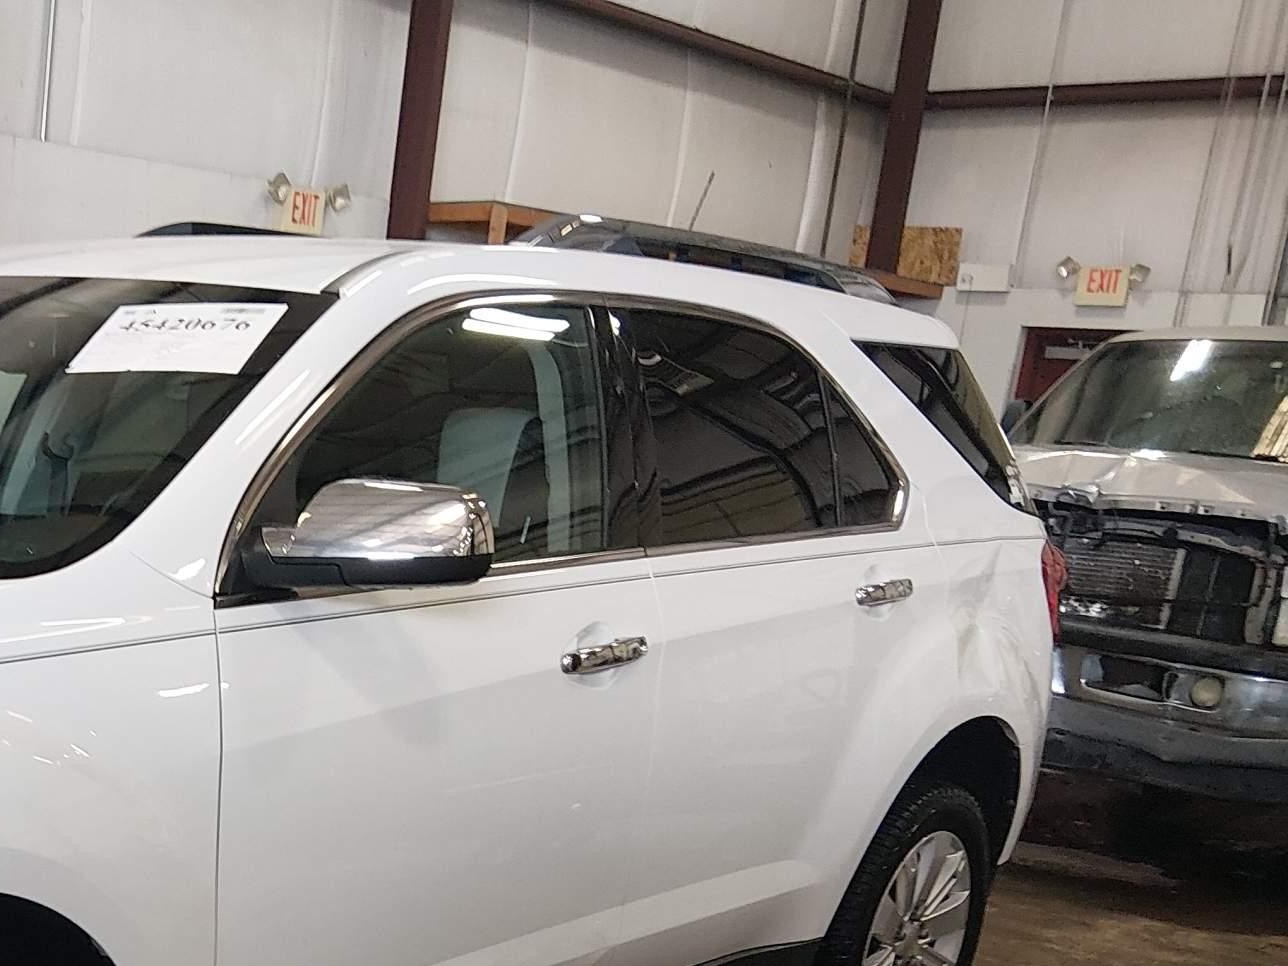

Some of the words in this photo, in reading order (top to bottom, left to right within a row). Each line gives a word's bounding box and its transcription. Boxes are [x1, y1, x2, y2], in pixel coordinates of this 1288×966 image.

[291, 191, 320, 227] EXIT
[1086, 268, 1123, 294] EXIT
[119, 317, 252, 332] 45420676
